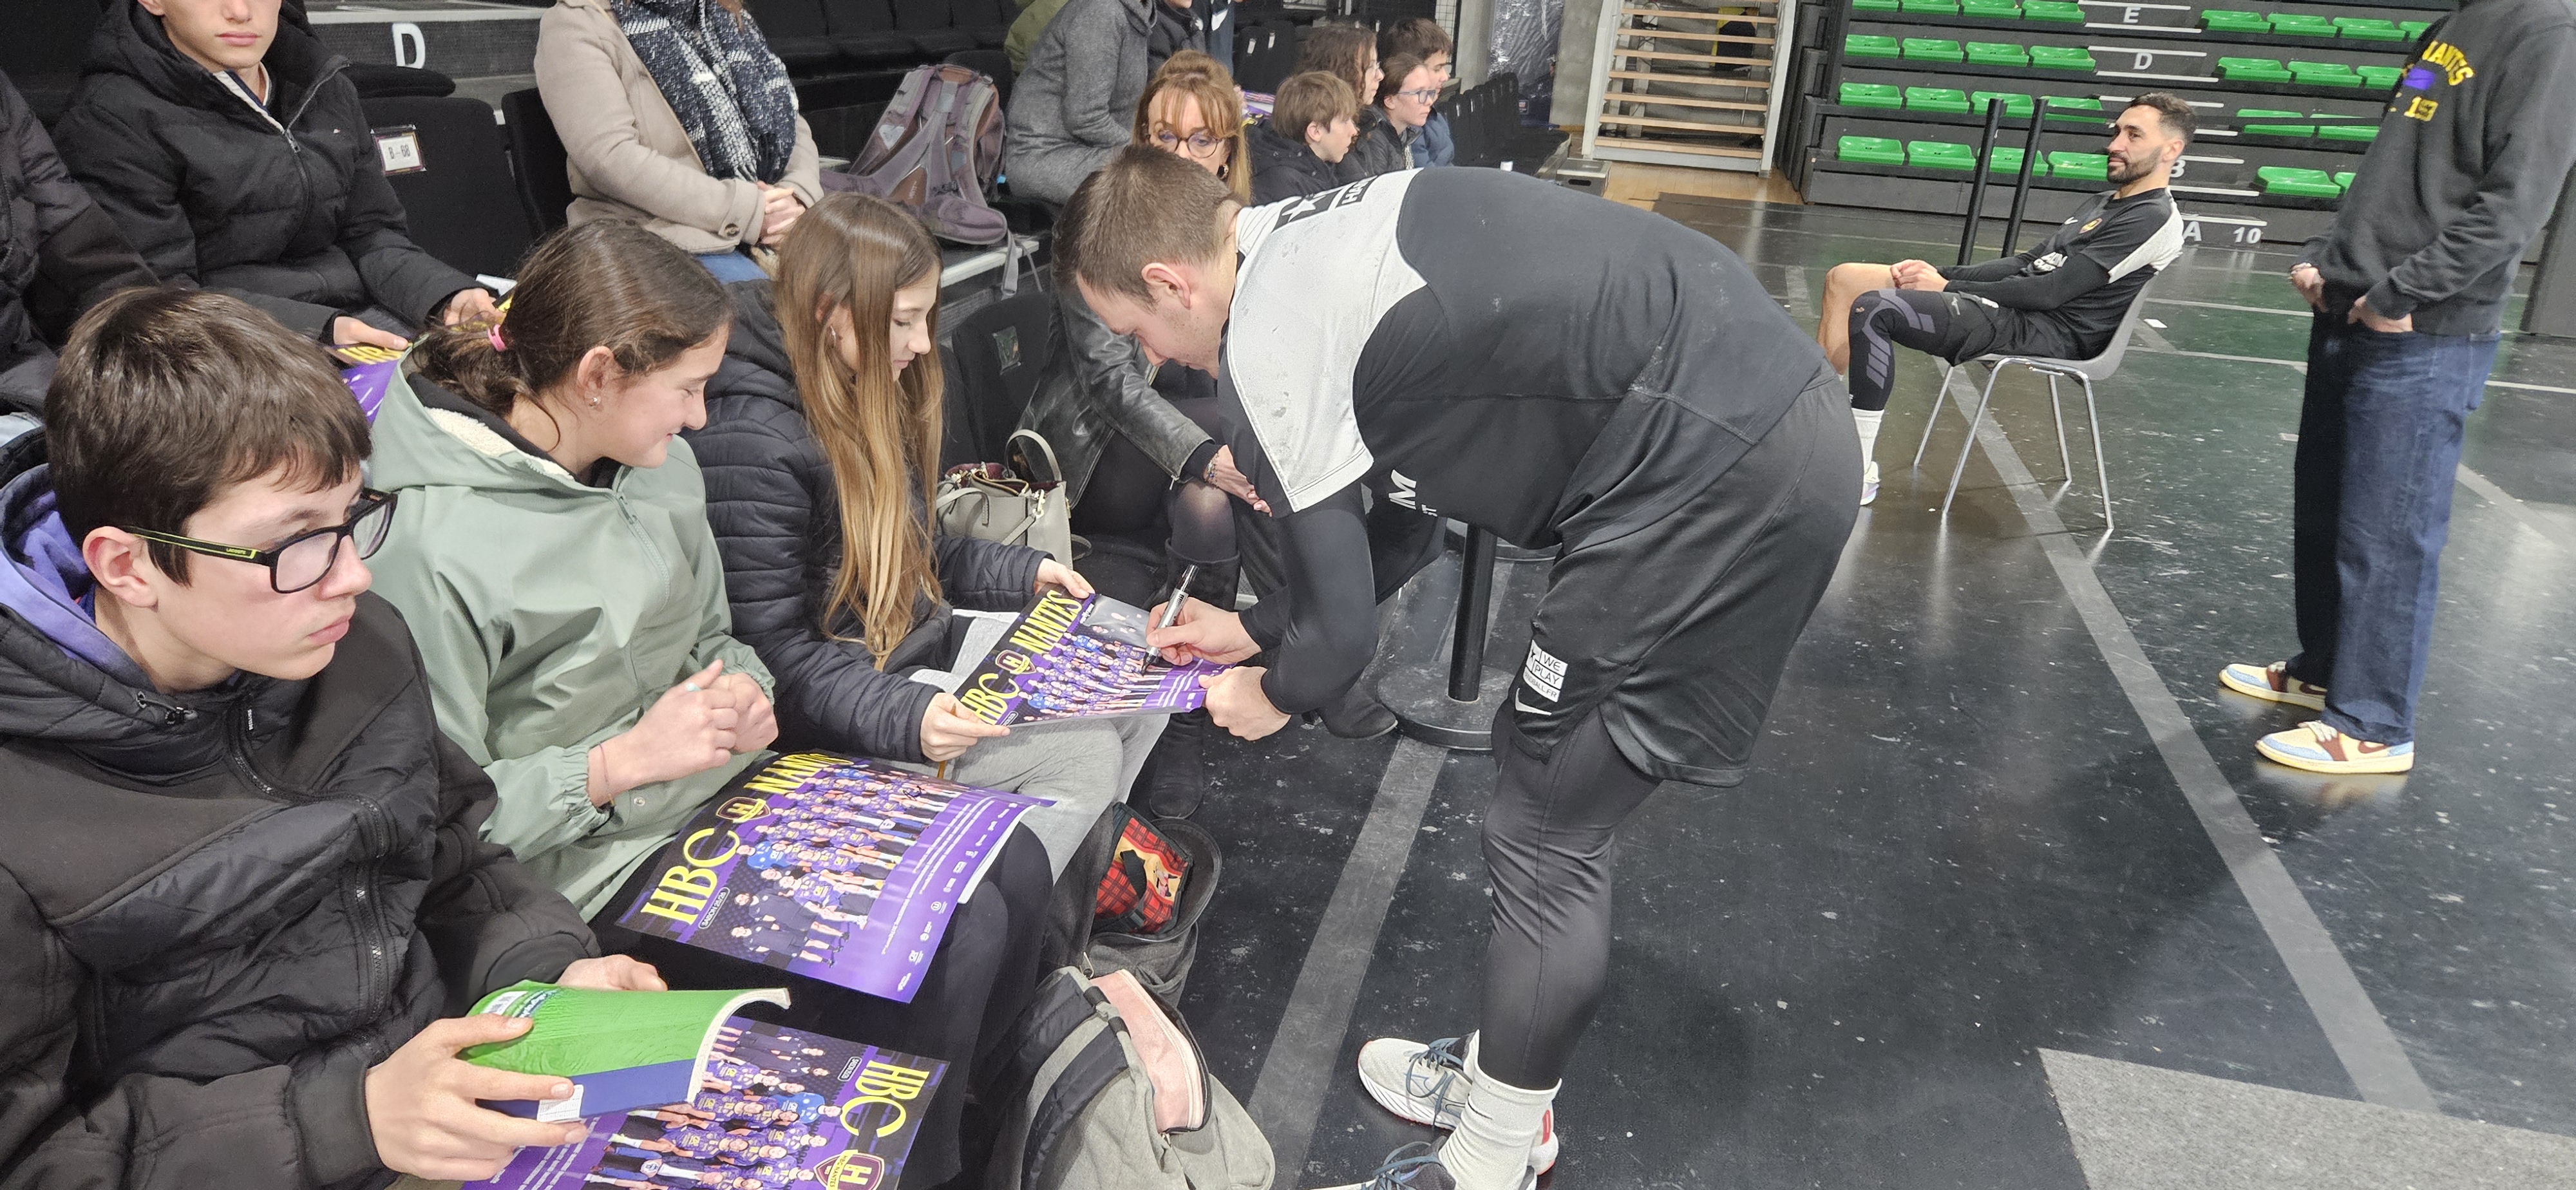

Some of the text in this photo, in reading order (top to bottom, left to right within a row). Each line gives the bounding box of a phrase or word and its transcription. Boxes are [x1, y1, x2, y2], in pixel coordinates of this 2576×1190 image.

[2123, 6, 2141, 23] E
[392, 23, 425, 69] D
[2133, 52, 2153, 70] D
[2170, 159, 2186, 178] B
[2183, 221, 2261, 243] A 10
[960, 673, 1020, 725] HBC
[1009, 589, 1083, 654] NANTES
[1544, 654, 1562, 672] WE
[1534, 664, 1560, 685] PLAY
[640, 827, 740, 925] HBC
[701, 891, 726, 926] SAISON 25/26
[840, 1060, 929, 1138] HBC
[829, 1166, 840, 1187] NANTES
